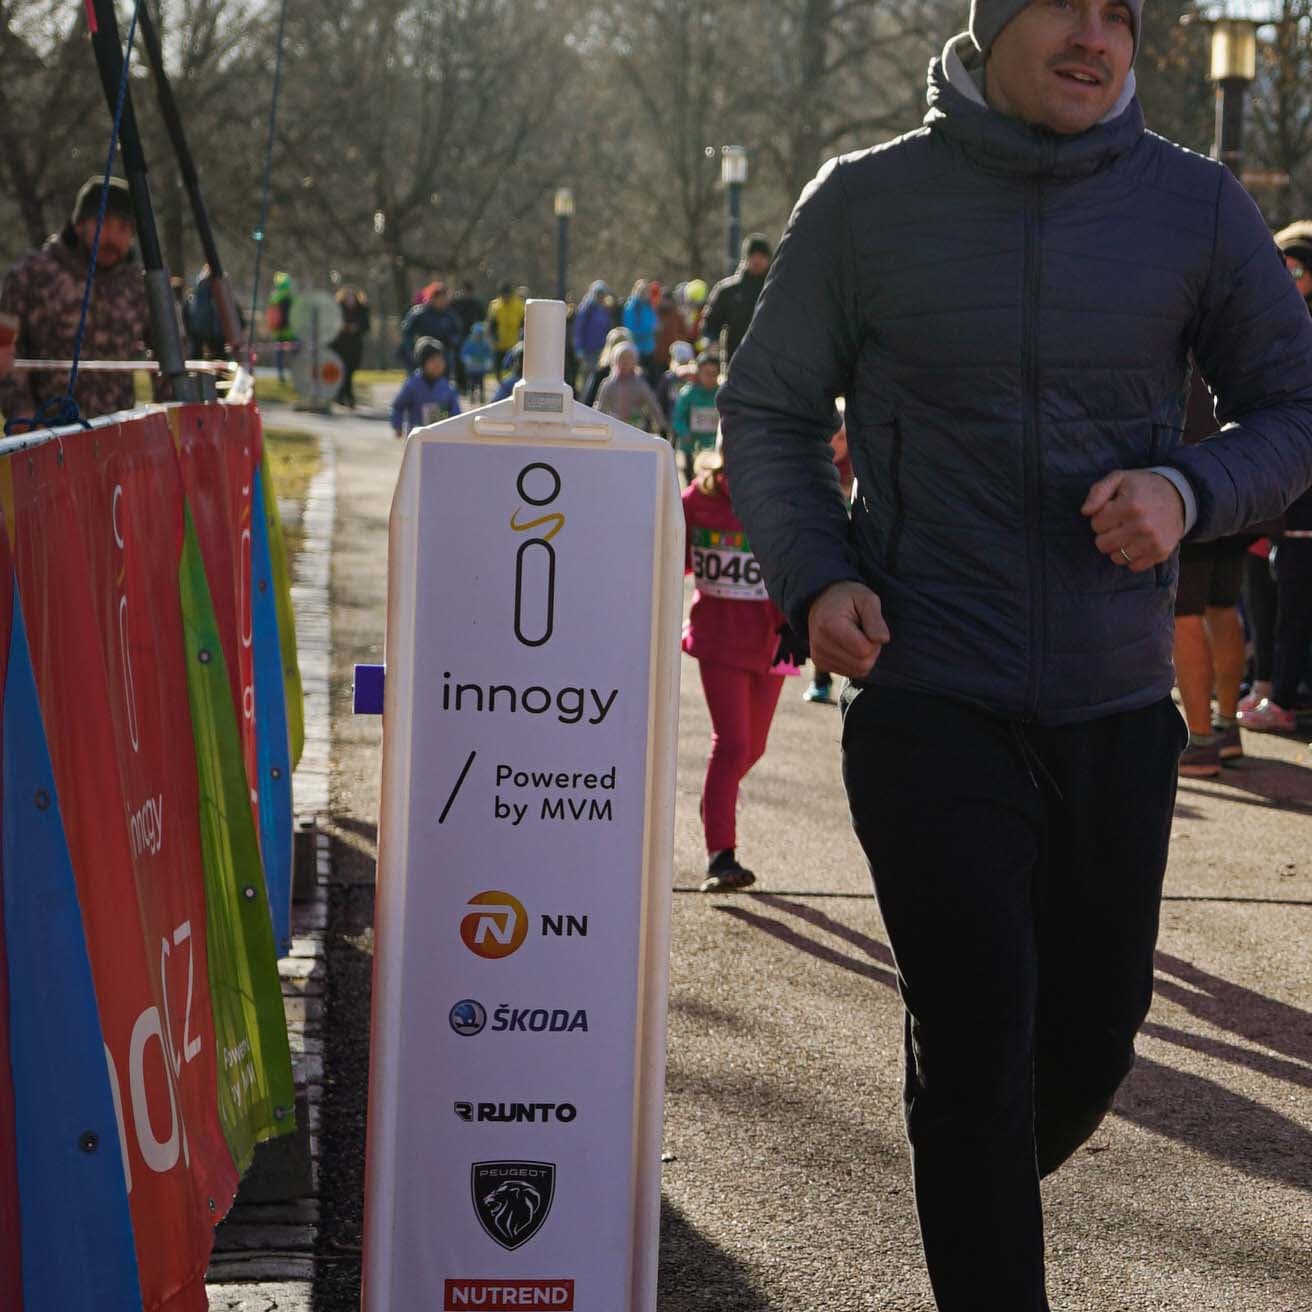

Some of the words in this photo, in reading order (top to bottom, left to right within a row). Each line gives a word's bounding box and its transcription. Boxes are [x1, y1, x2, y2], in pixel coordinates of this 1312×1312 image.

[694, 552, 760, 584] 3046
[442, 672, 619, 725] innogy
[496, 764, 617, 791] Powered
[494, 797, 529, 827] by
[541, 798, 613, 822] MVM
[541, 915, 588, 937] NN
[491, 1003, 588, 1032] ŠKODA
[477, 1102, 577, 1123] RUNTO
[479, 1167, 549, 1178] PEUGEOT
[451, 1286, 569, 1306] NUTREND
